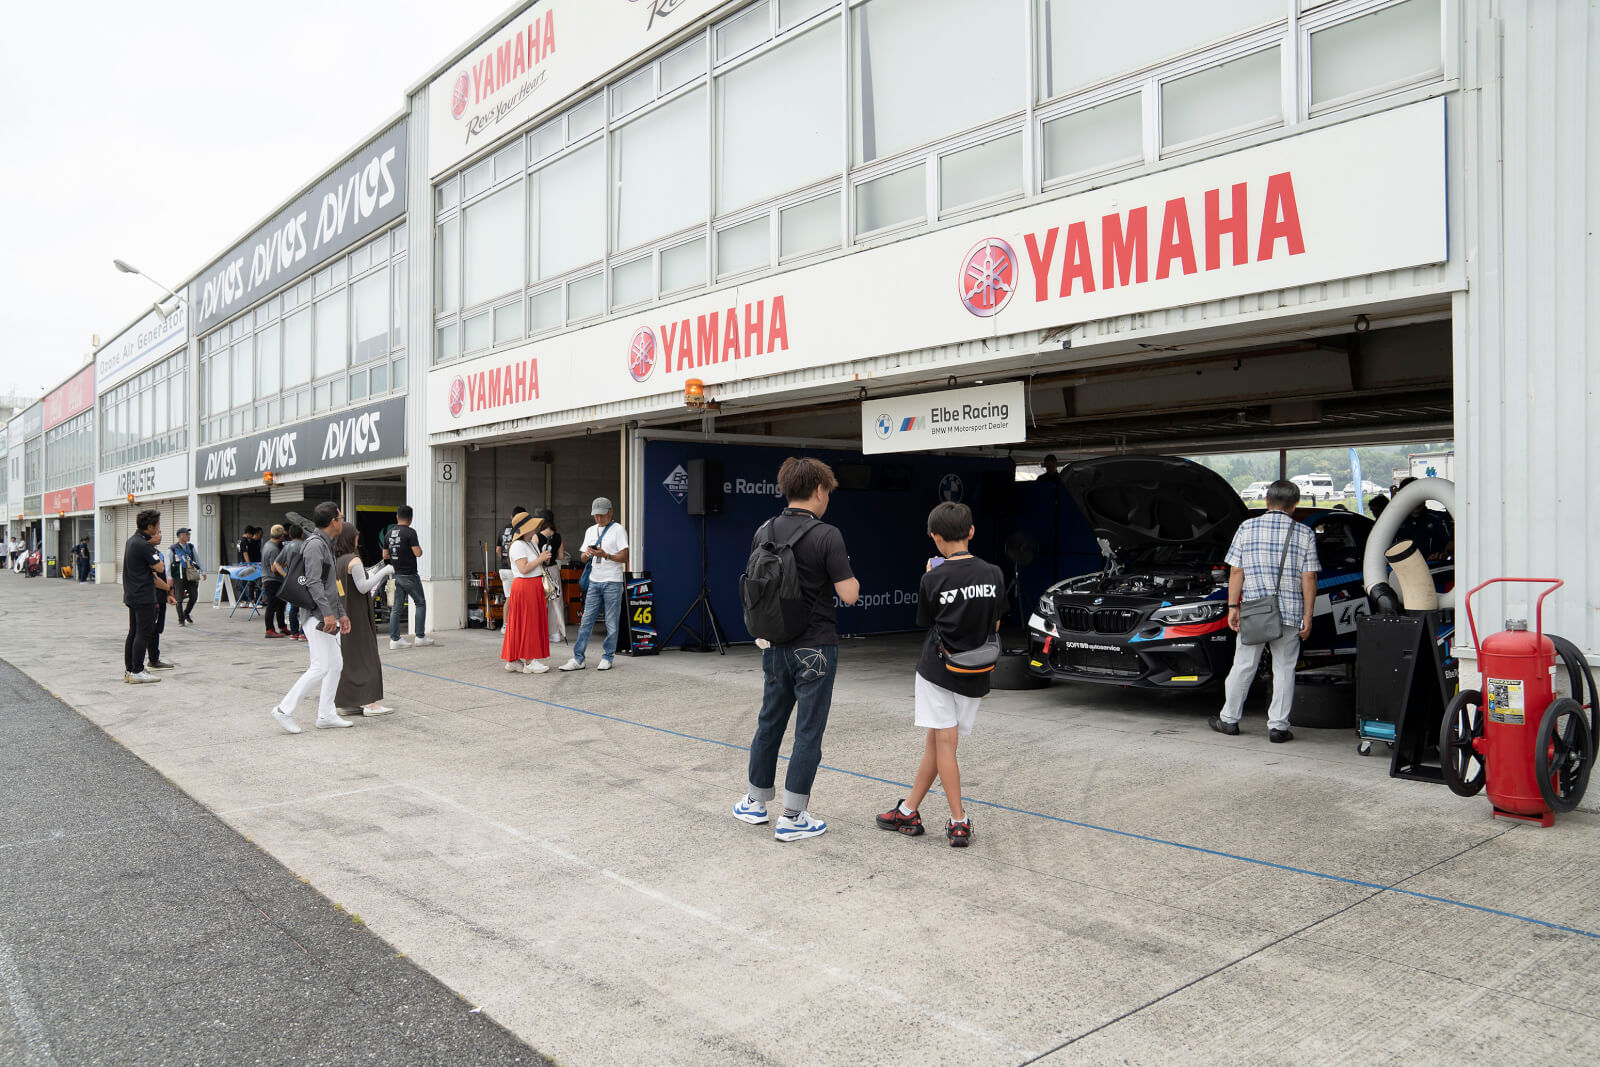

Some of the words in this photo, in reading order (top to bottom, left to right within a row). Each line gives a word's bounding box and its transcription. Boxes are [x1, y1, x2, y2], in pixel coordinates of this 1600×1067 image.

[472, 8, 557, 105] YAMAHA
[465, 106, 496, 144] Revs
[496, 92, 519, 124] Your
[519, 69, 547, 101] Heart
[1023, 171, 1306, 303] YAMAHA
[123, 343, 134, 361] Air
[137, 308, 184, 350] Generator
[660, 295, 789, 374] YAMAHA
[467, 358, 540, 413] YAMAHA
[931, 406, 960, 423] Elbe
[962, 401, 1009, 421] Racing
[931, 426, 947, 435] BMW
[948, 425, 953, 434] M
[954, 424, 988, 434] Motorsport
[988, 421, 1009, 430] Dealer
[442, 464, 453, 481] 8
[205, 505, 213, 515] 9
[960, 584, 997, 600] YONEX
[633, 606, 652, 624] 46
